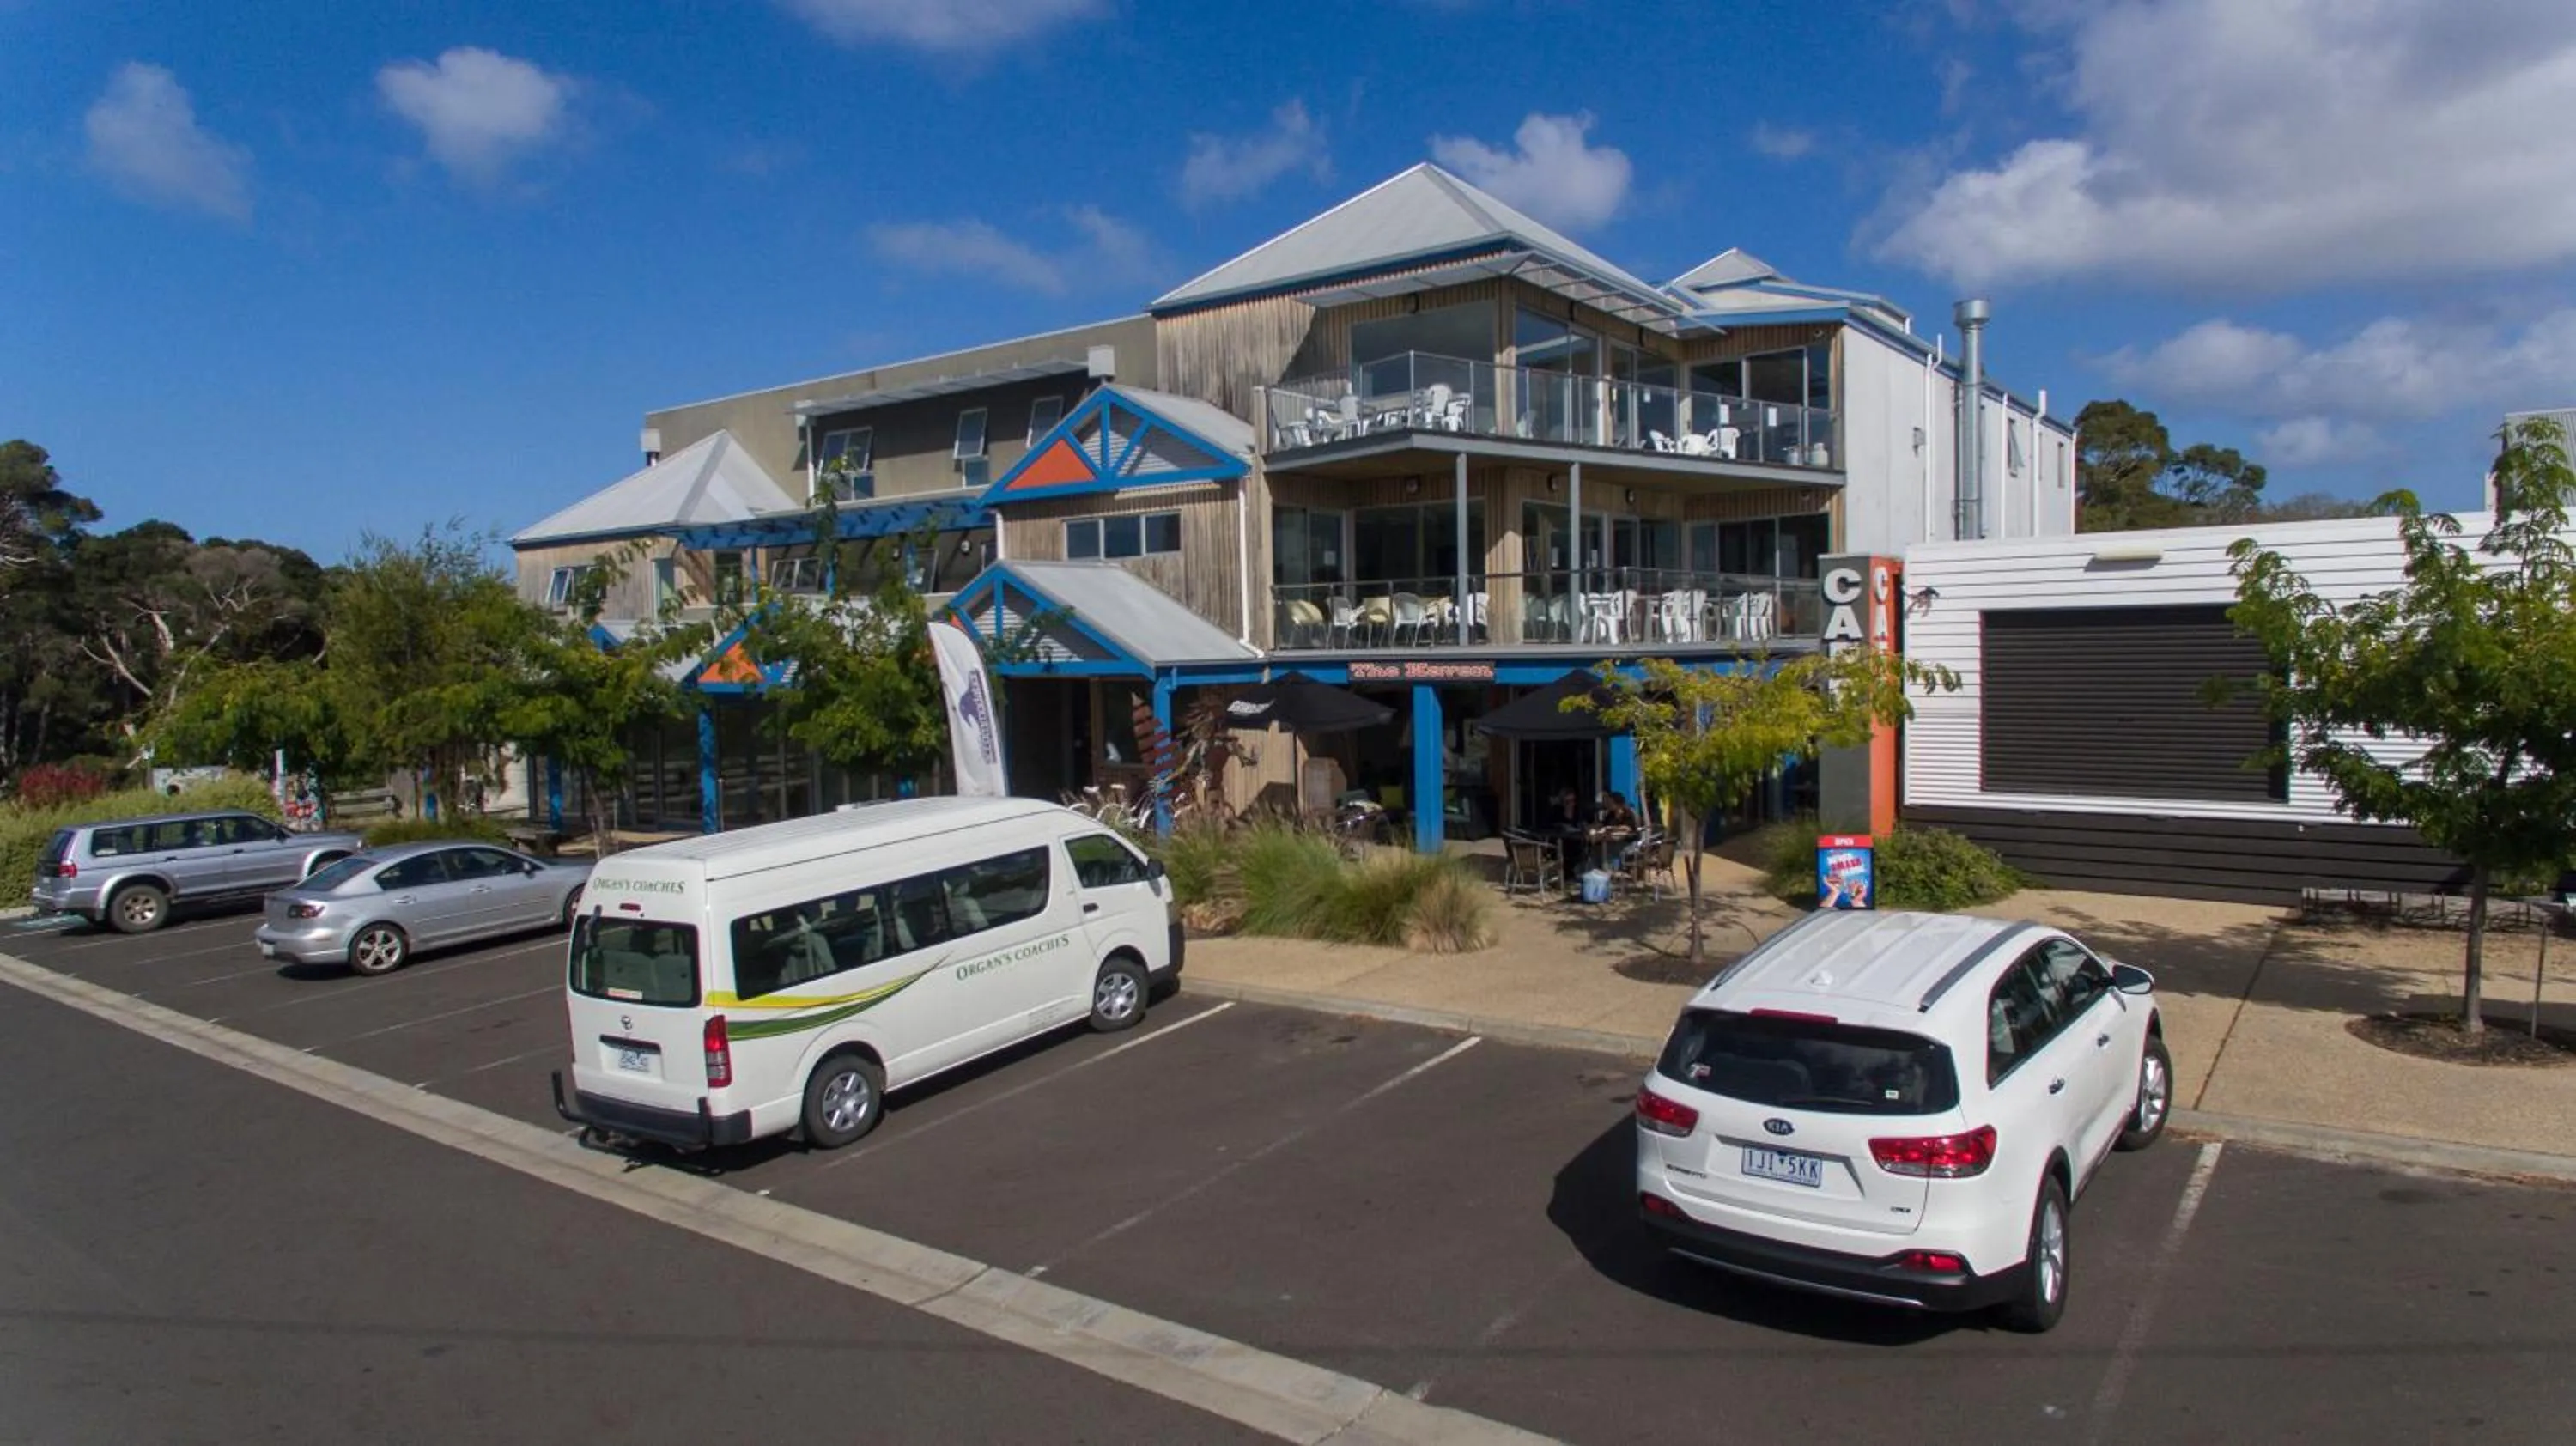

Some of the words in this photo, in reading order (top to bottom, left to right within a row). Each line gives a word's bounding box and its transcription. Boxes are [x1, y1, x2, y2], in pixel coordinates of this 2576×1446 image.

[1350, 662, 1400, 677] The
[592, 878, 630, 890] ORGAN'S
[633, 880, 685, 893] COACHES
[956, 952, 1012, 980] ORGAN'S
[1014, 934, 1069, 961] COACHES
[1766, 1120, 1791, 1133] KIA
